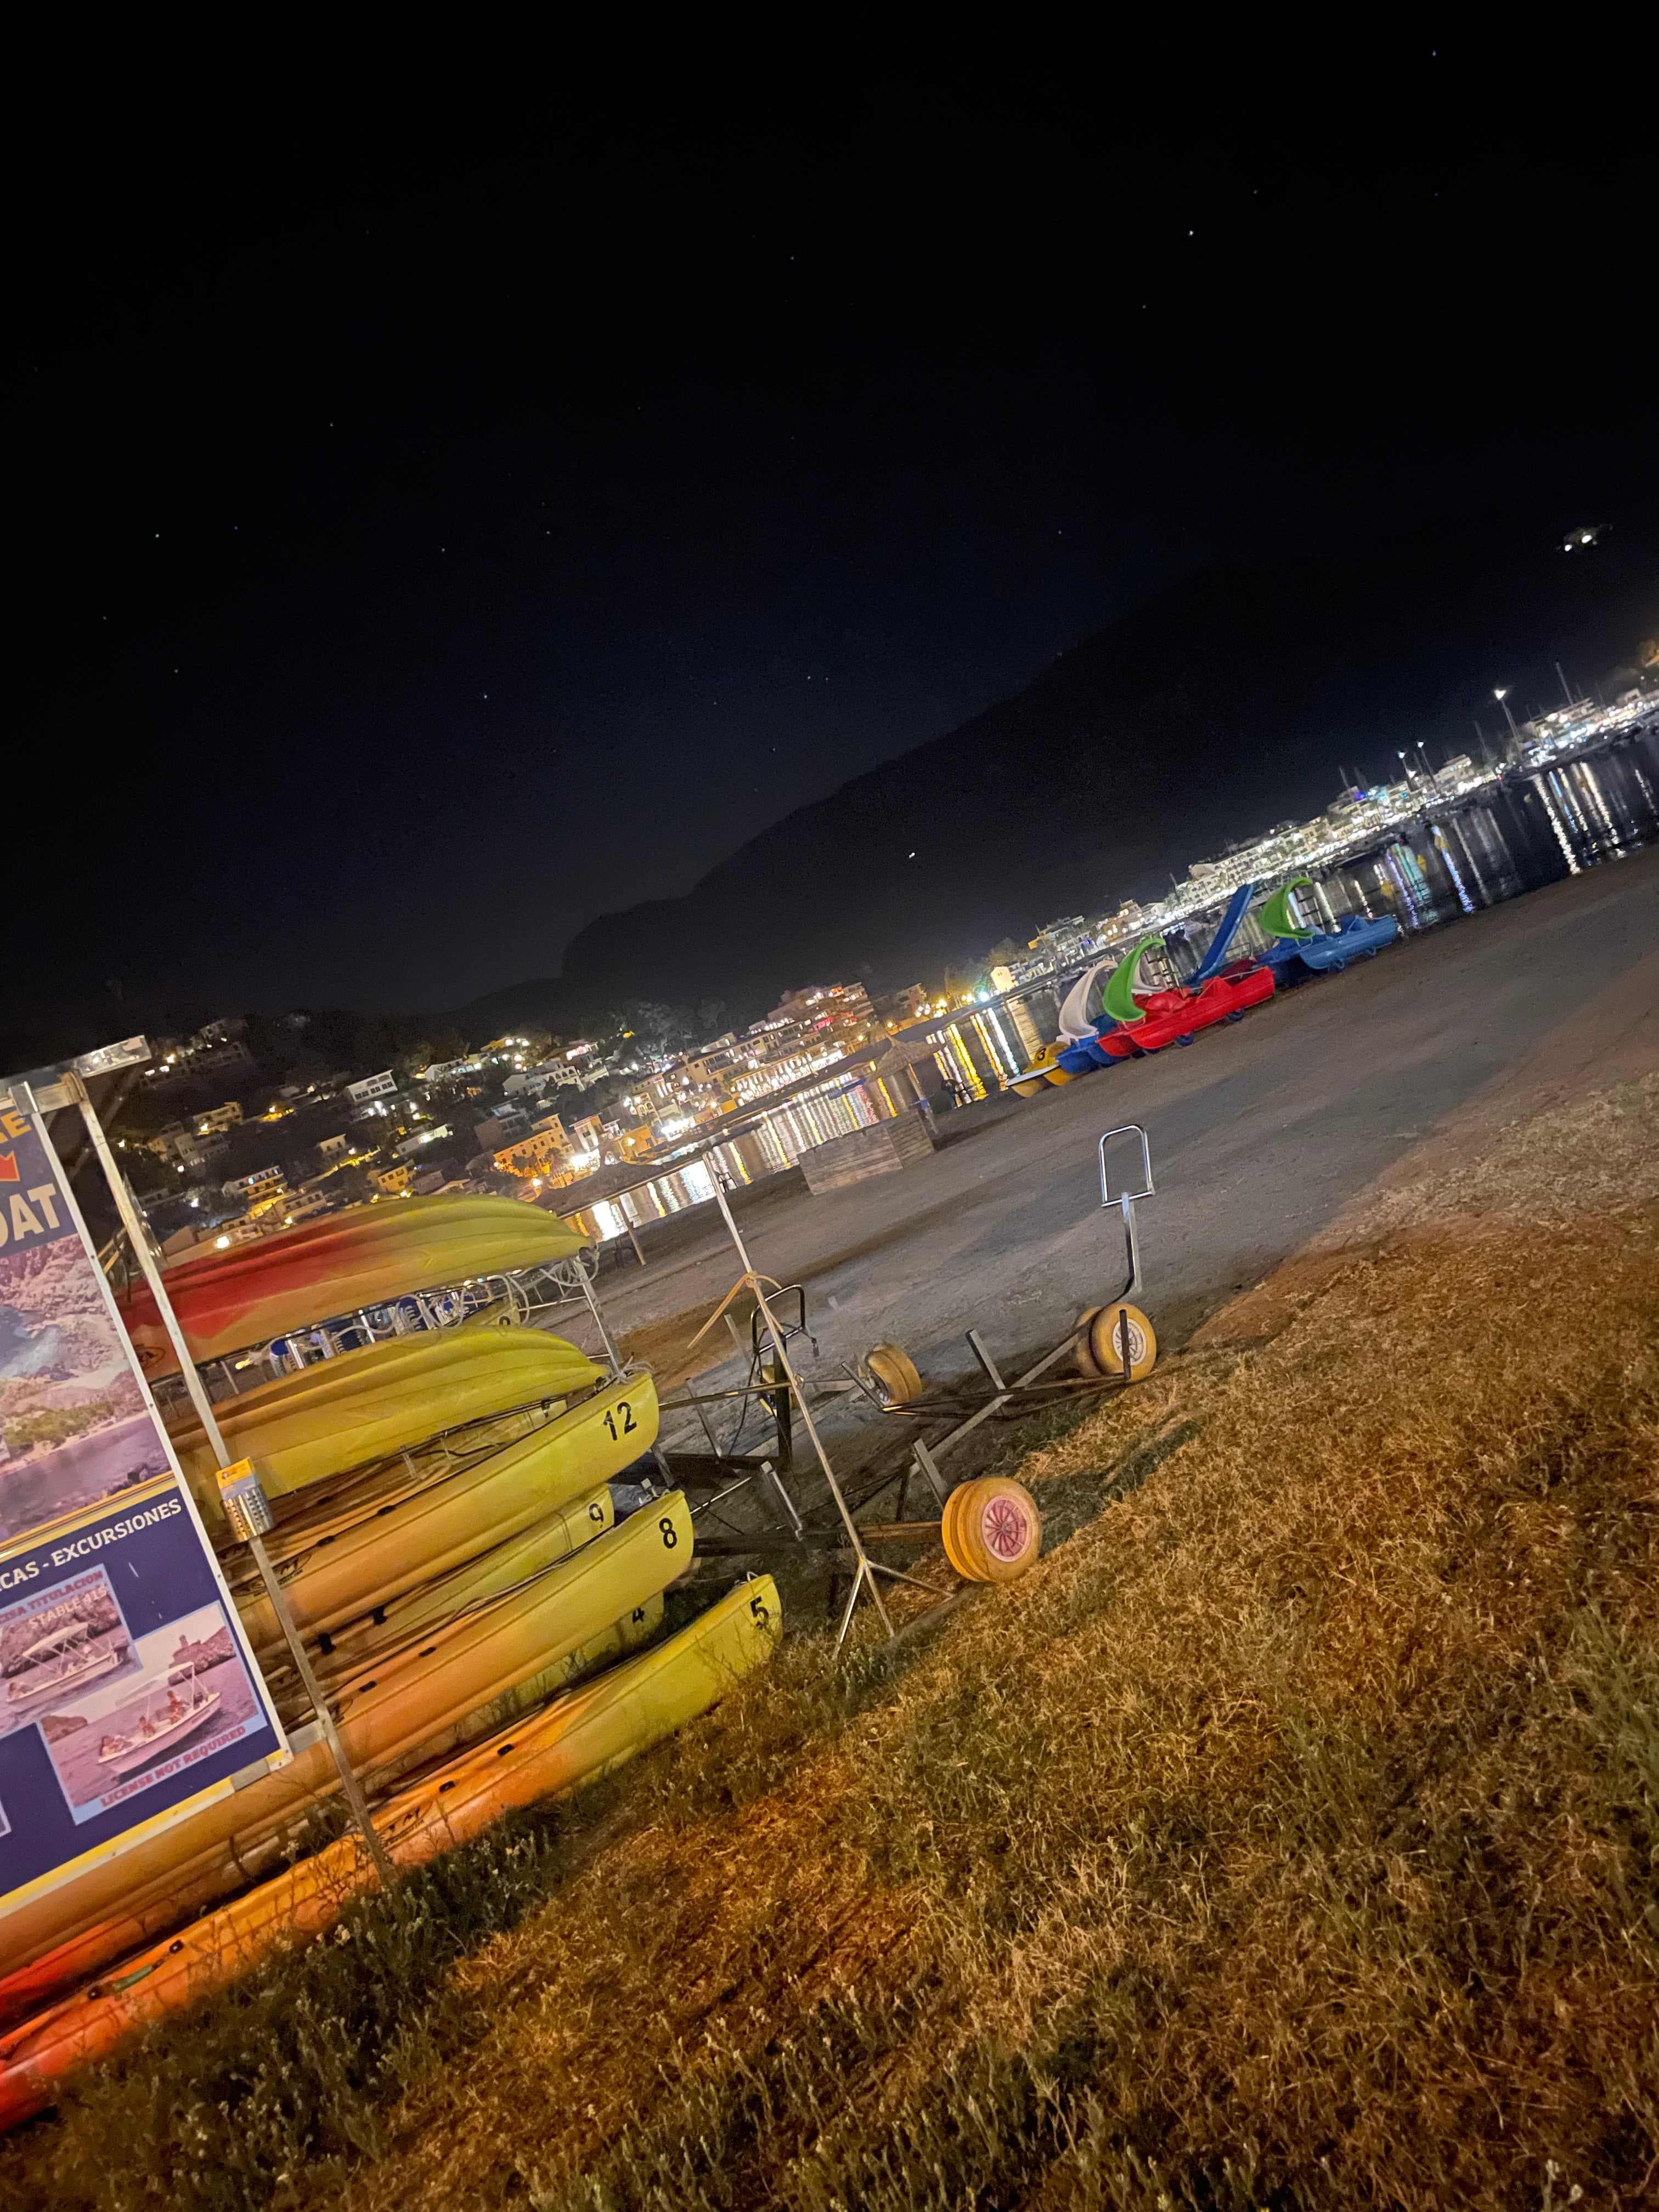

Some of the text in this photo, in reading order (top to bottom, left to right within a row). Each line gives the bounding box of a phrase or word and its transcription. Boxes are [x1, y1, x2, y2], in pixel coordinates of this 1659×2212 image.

[603, 1401, 637, 1441] 12
[50, 1498, 182, 1567] EXCURSIONES
[589, 1503, 604, 1528] 9
[659, 1517, 678, 1549] 8
[28, 1595, 81, 1629] STABLE
[749, 1596, 769, 1630] 5
[100, 1725, 246, 1807] LICENSE NOT REQUIRED
